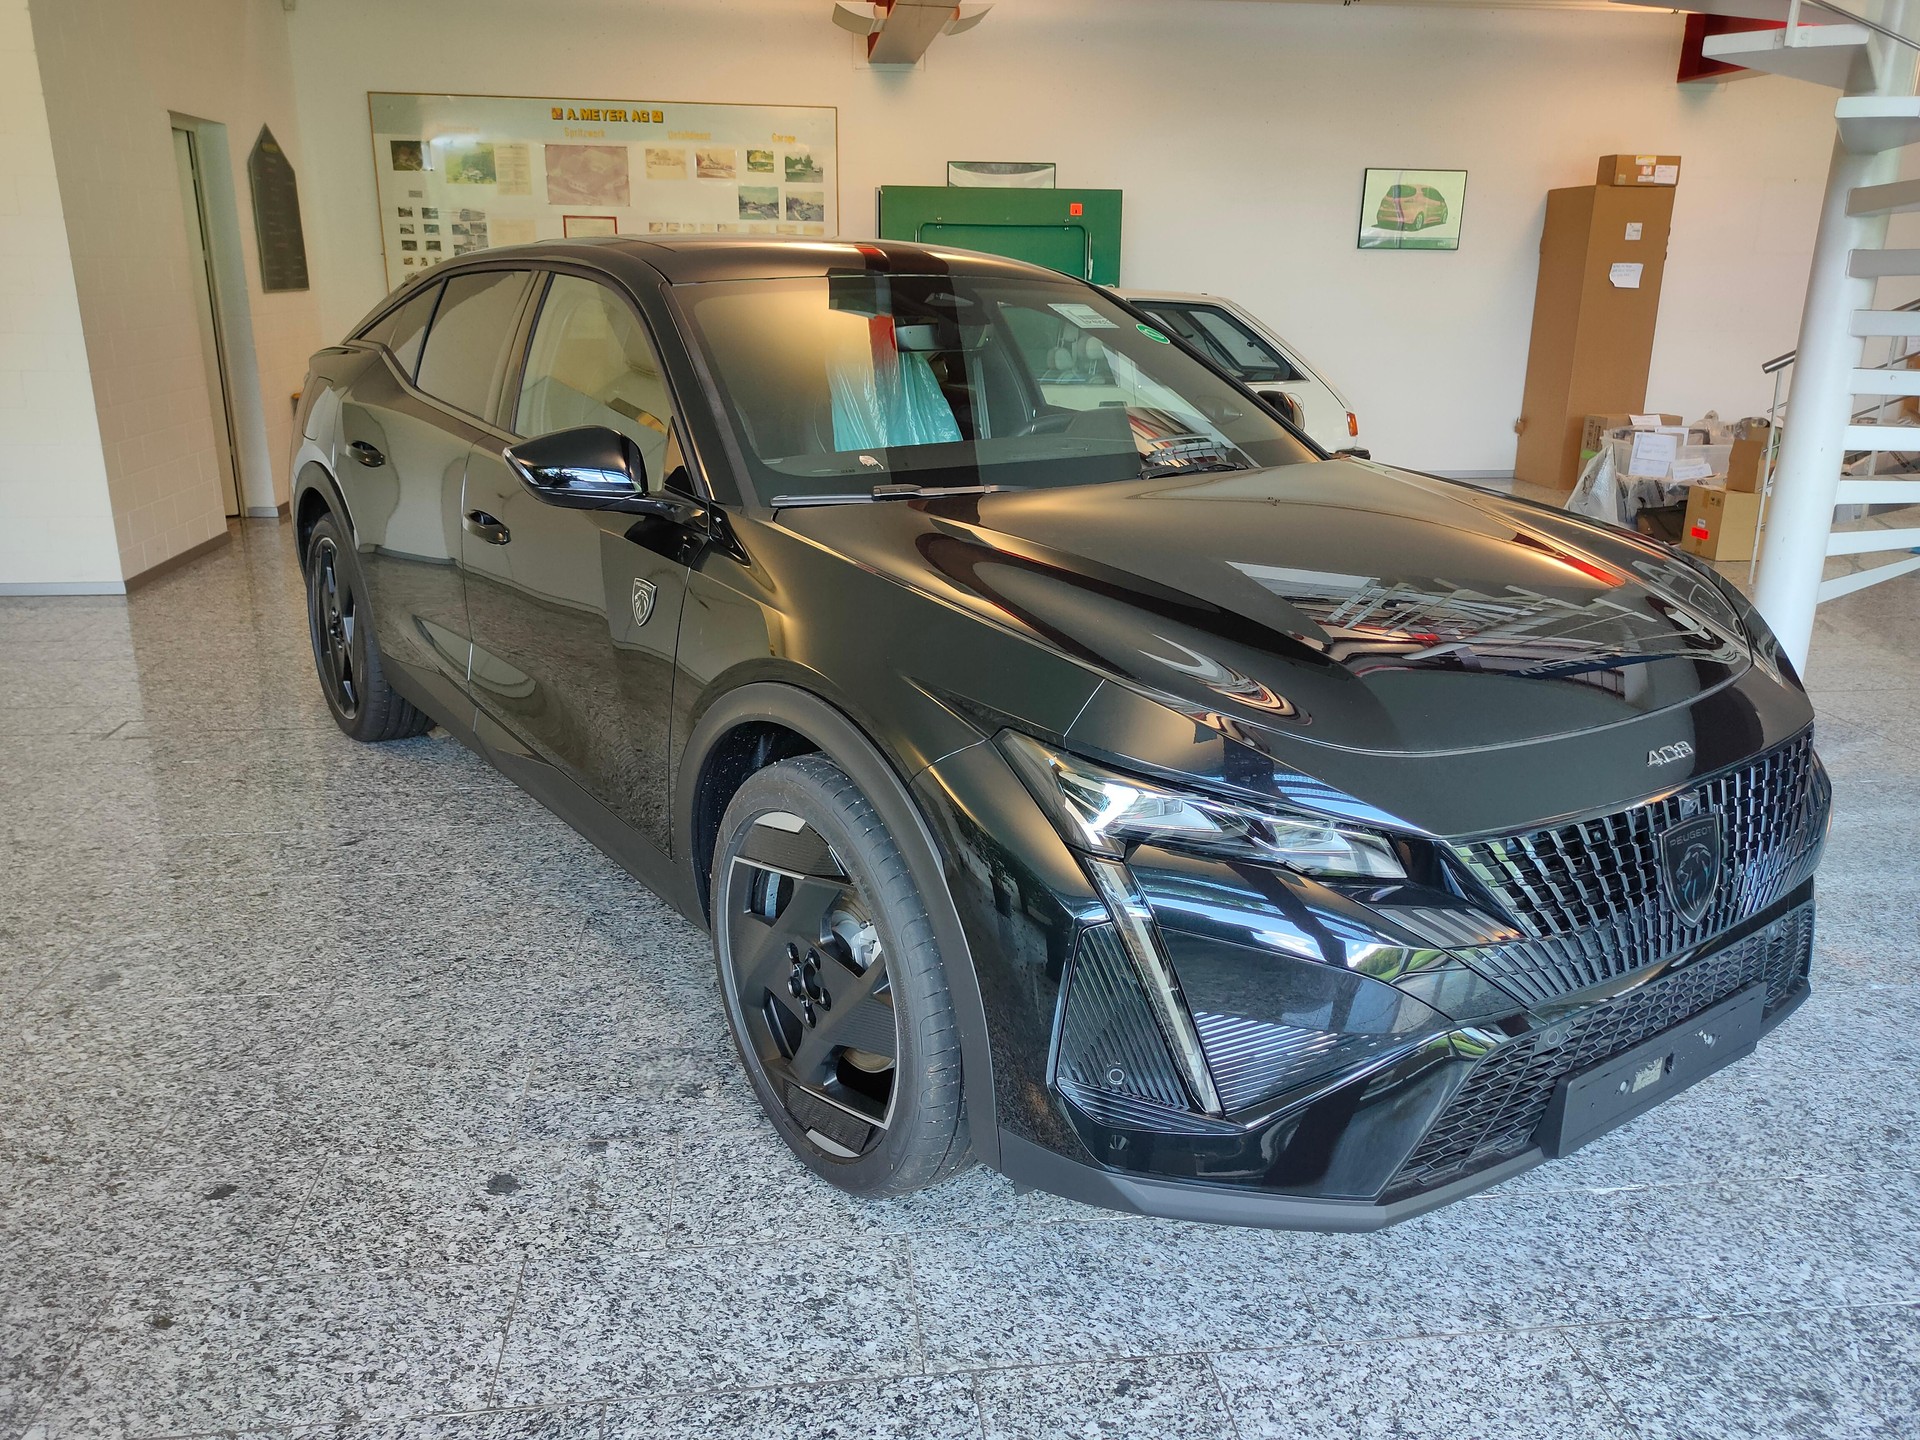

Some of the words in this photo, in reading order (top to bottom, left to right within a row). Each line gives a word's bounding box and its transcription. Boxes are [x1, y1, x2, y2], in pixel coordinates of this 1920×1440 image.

[632, 109, 650, 123] AG
[1647, 740, 1694, 767] 408
[1669, 825, 1713, 847] PEUGEOT
